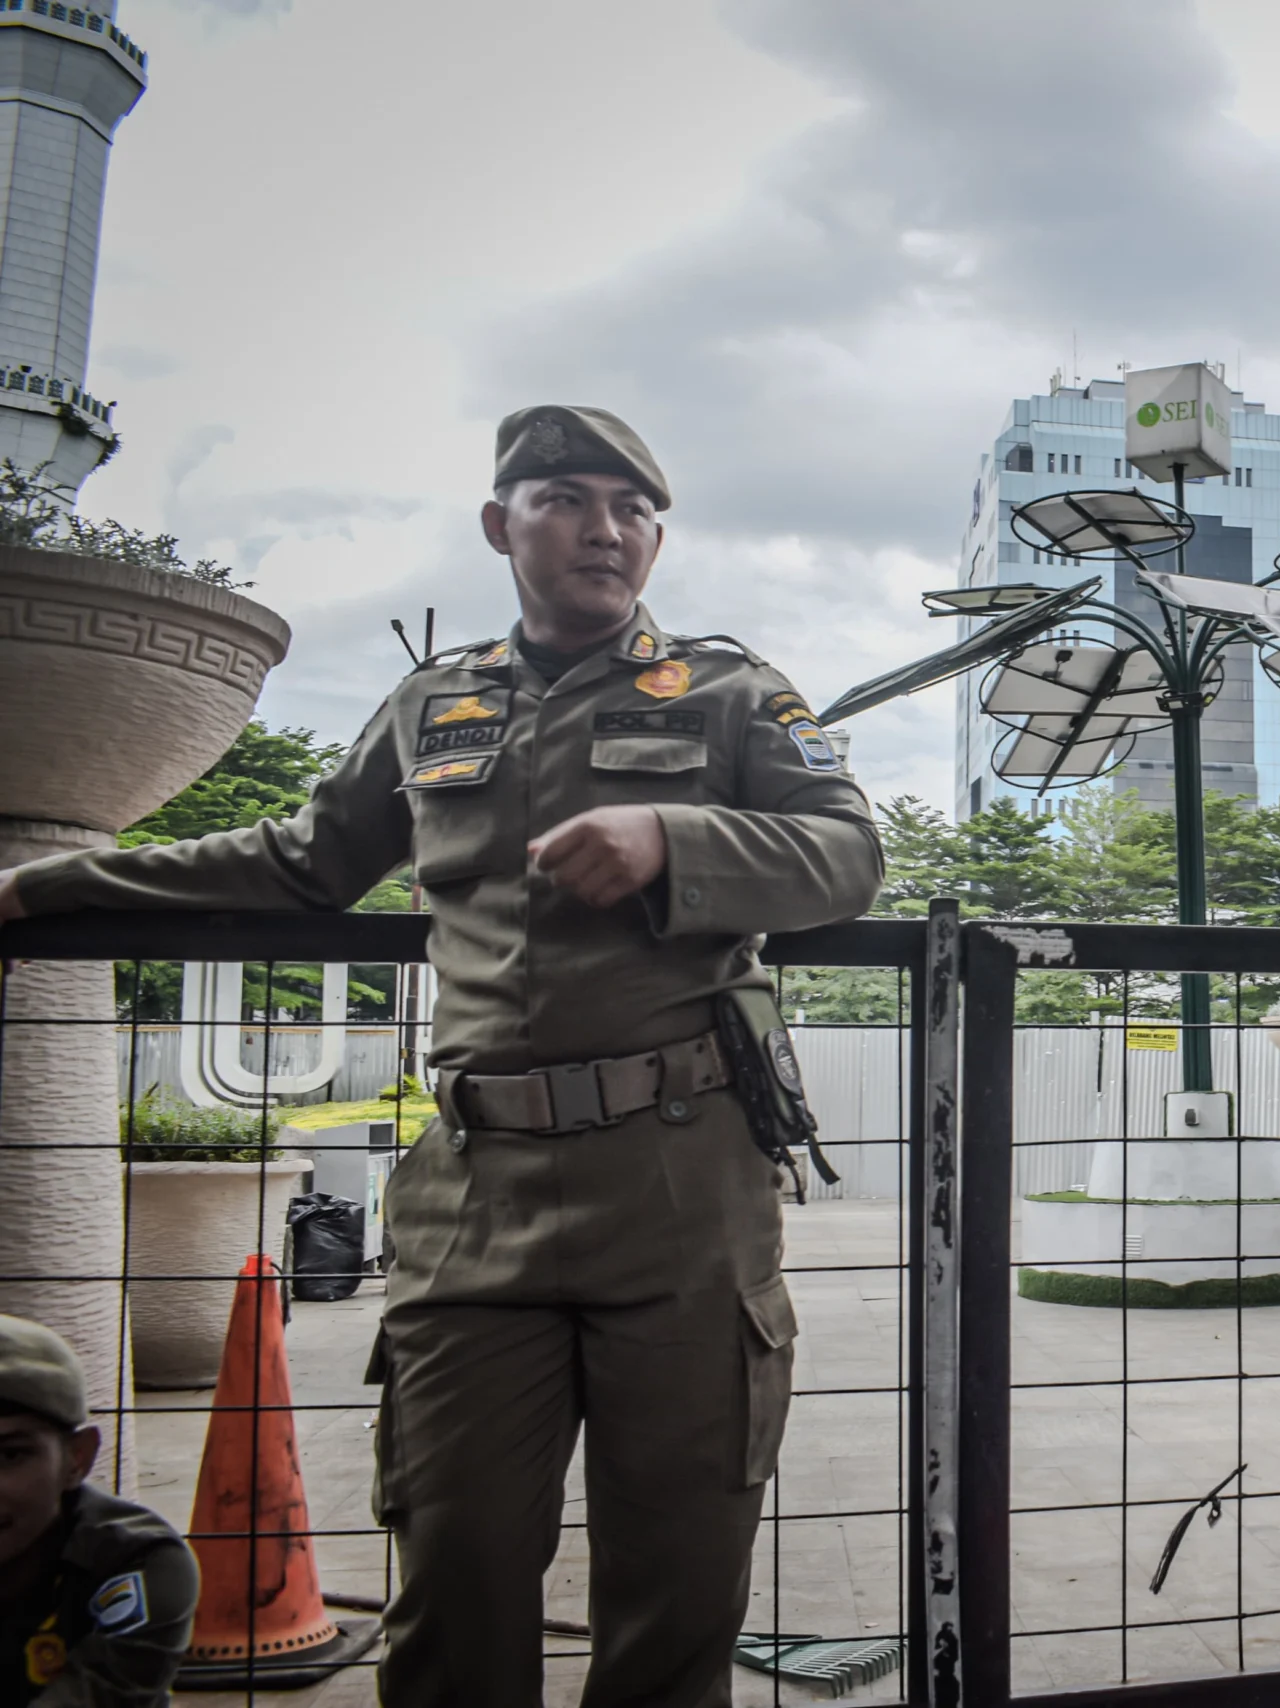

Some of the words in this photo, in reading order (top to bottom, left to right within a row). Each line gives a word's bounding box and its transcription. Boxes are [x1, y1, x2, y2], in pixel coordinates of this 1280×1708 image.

[1162, 399, 1198, 423] SEI
[596, 713, 652, 731] POL
[666, 713, 700, 732] PP
[424, 727, 495, 751] DENDI
